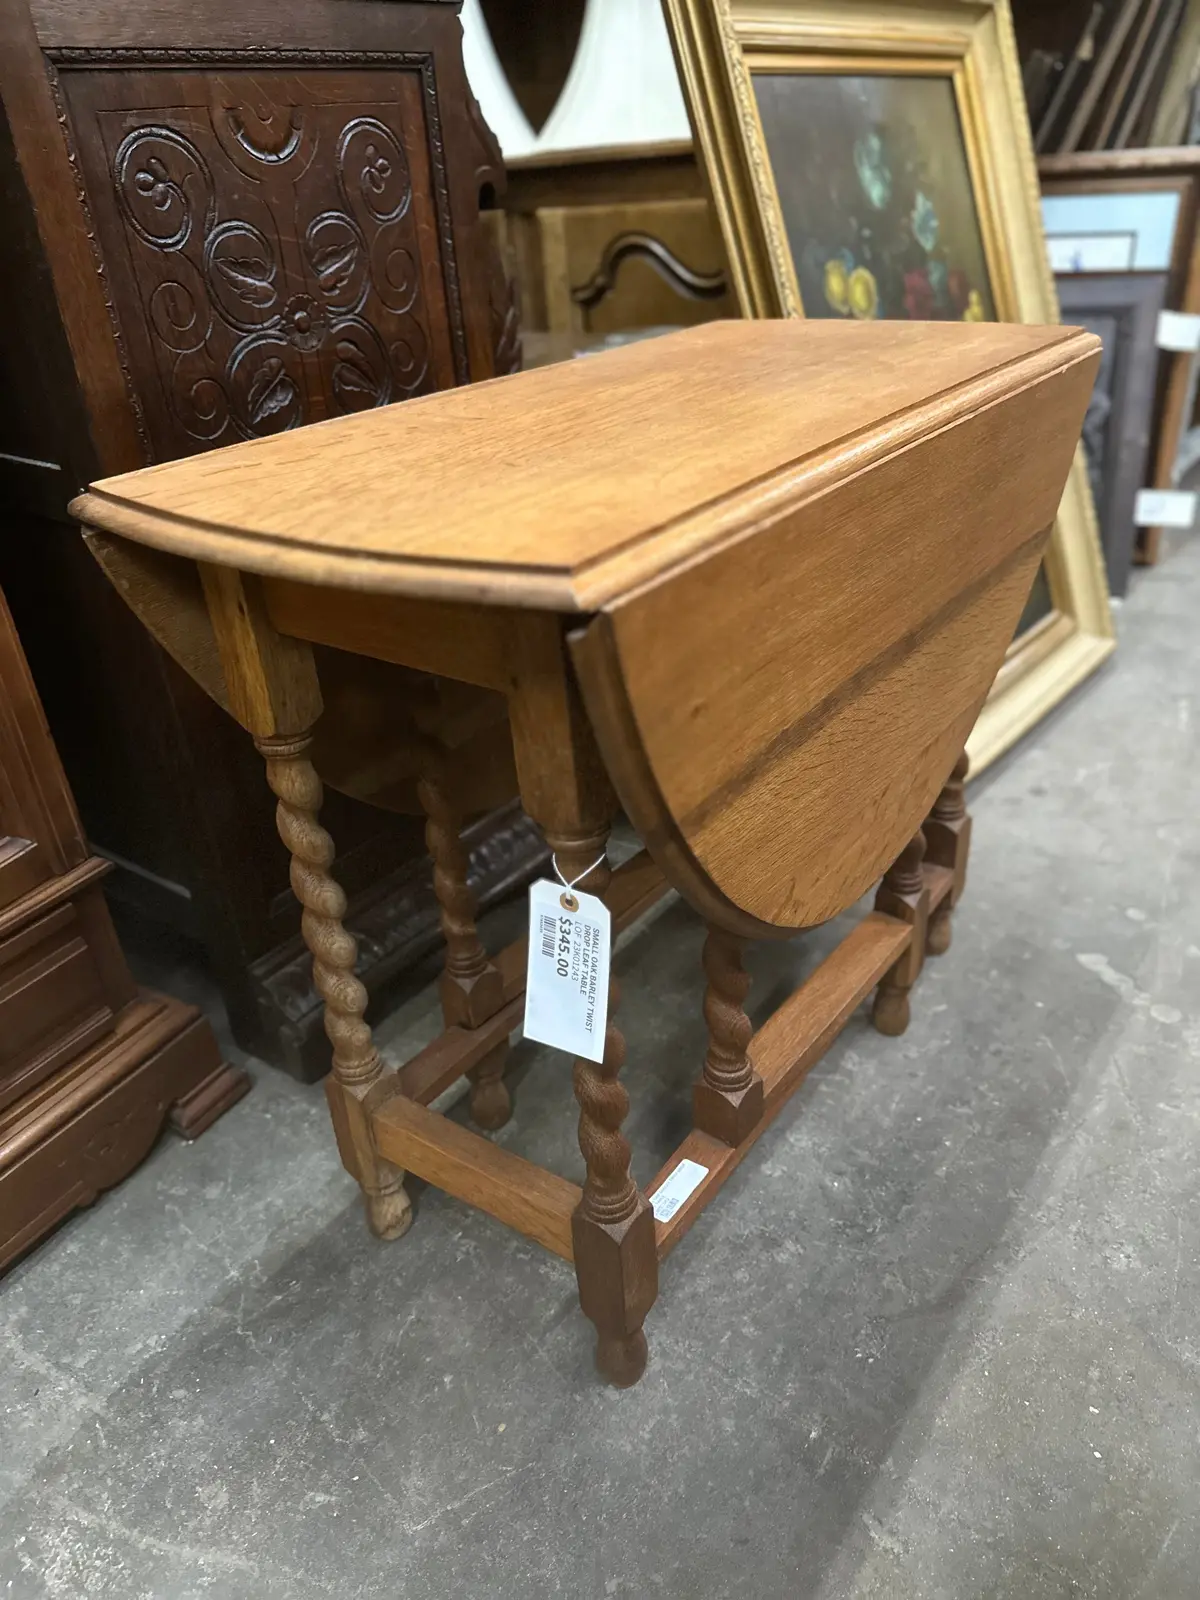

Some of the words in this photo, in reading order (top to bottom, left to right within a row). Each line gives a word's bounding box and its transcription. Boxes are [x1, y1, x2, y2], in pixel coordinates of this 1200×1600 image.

[574, 922, 582, 938] LOF
[583, 924, 591, 948] DROP
[591, 927, 599, 953] SMALL
[556, 916, 573, 977] $345.00
[571, 941, 581, 982] 23K01243
[590, 957, 598, 973] OAK
[580, 970, 588, 996] TABLE
[588, 972, 597, 1007] BARLEY
[585, 1008, 594, 1033] TWIST
